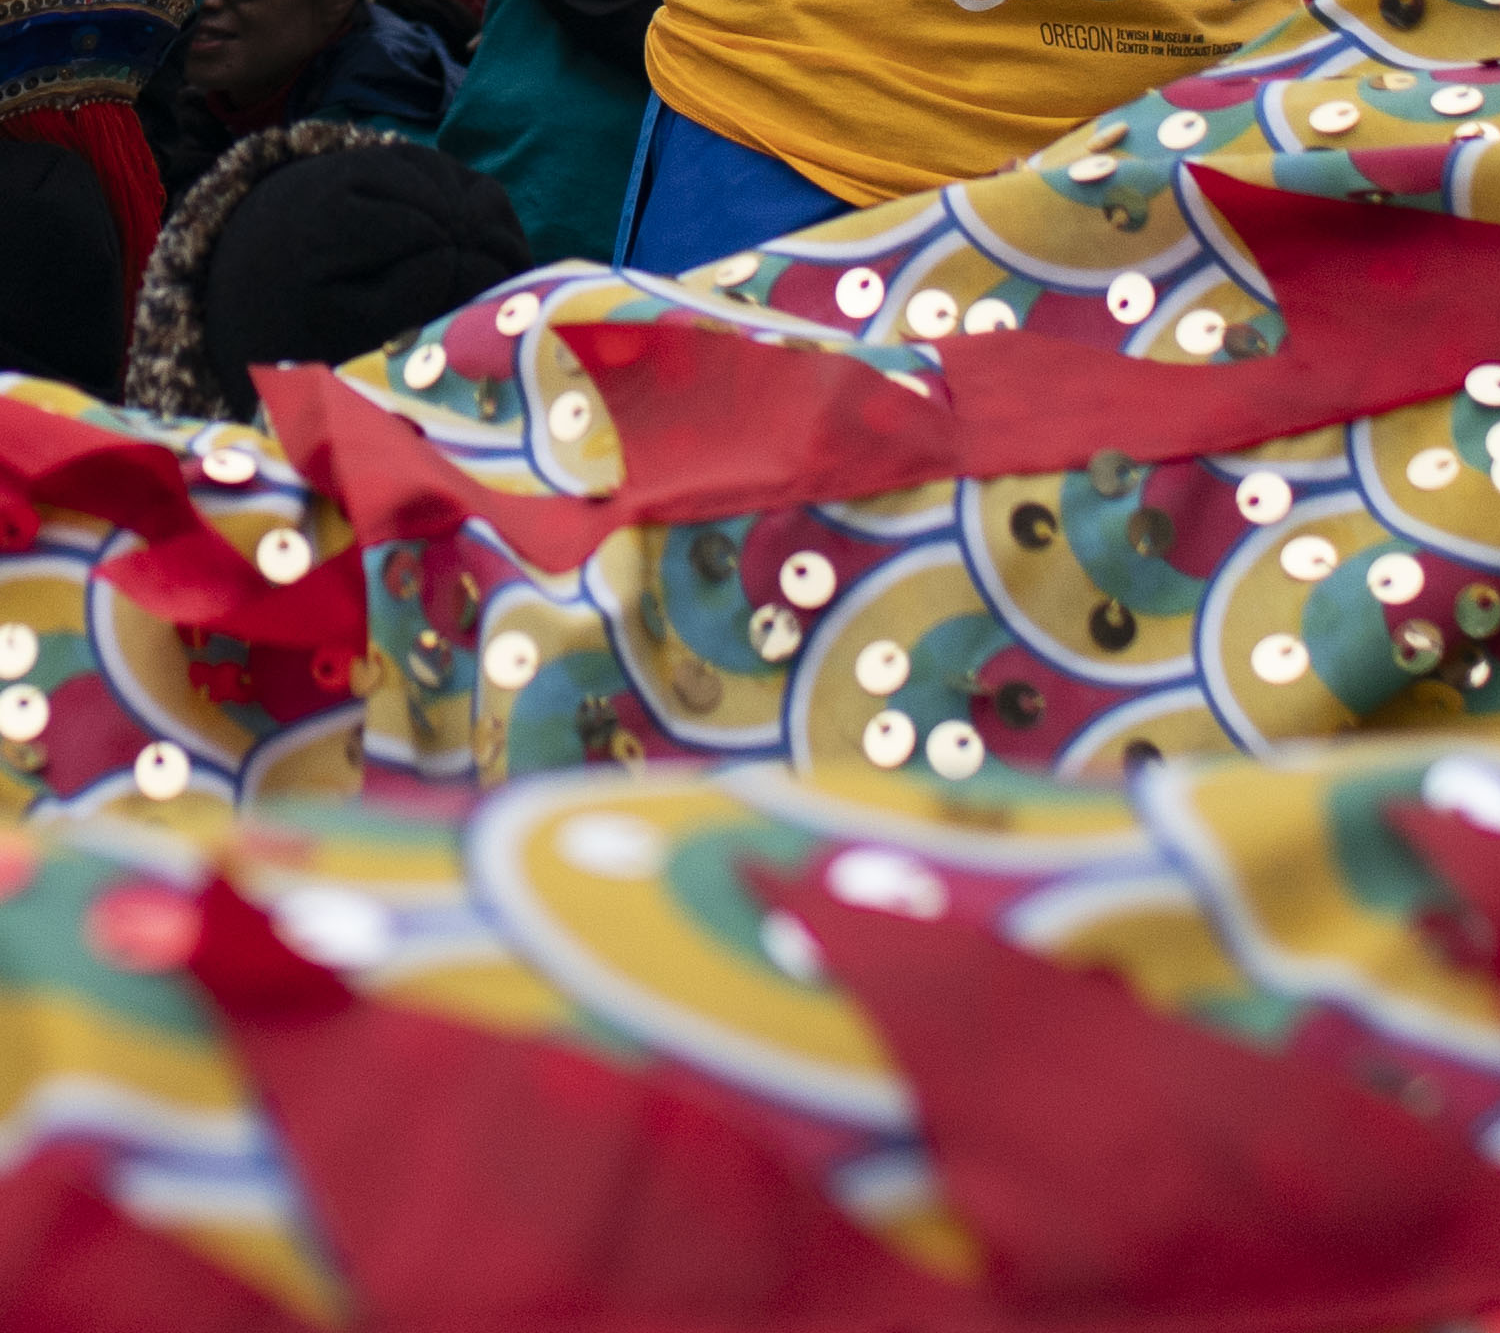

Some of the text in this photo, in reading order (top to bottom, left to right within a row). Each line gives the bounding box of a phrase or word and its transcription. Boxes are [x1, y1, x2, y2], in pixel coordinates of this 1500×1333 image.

[1039, 22, 1114, 53] OREGON
[1116, 28, 1149, 41] JEWISH
[1152, 29, 1191, 43] MUSEUM
[1116, 41, 1149, 55] CENTER
[1151, 47, 1165, 56] FOR
[1166, 43, 1212, 57] HOLOCAUST
